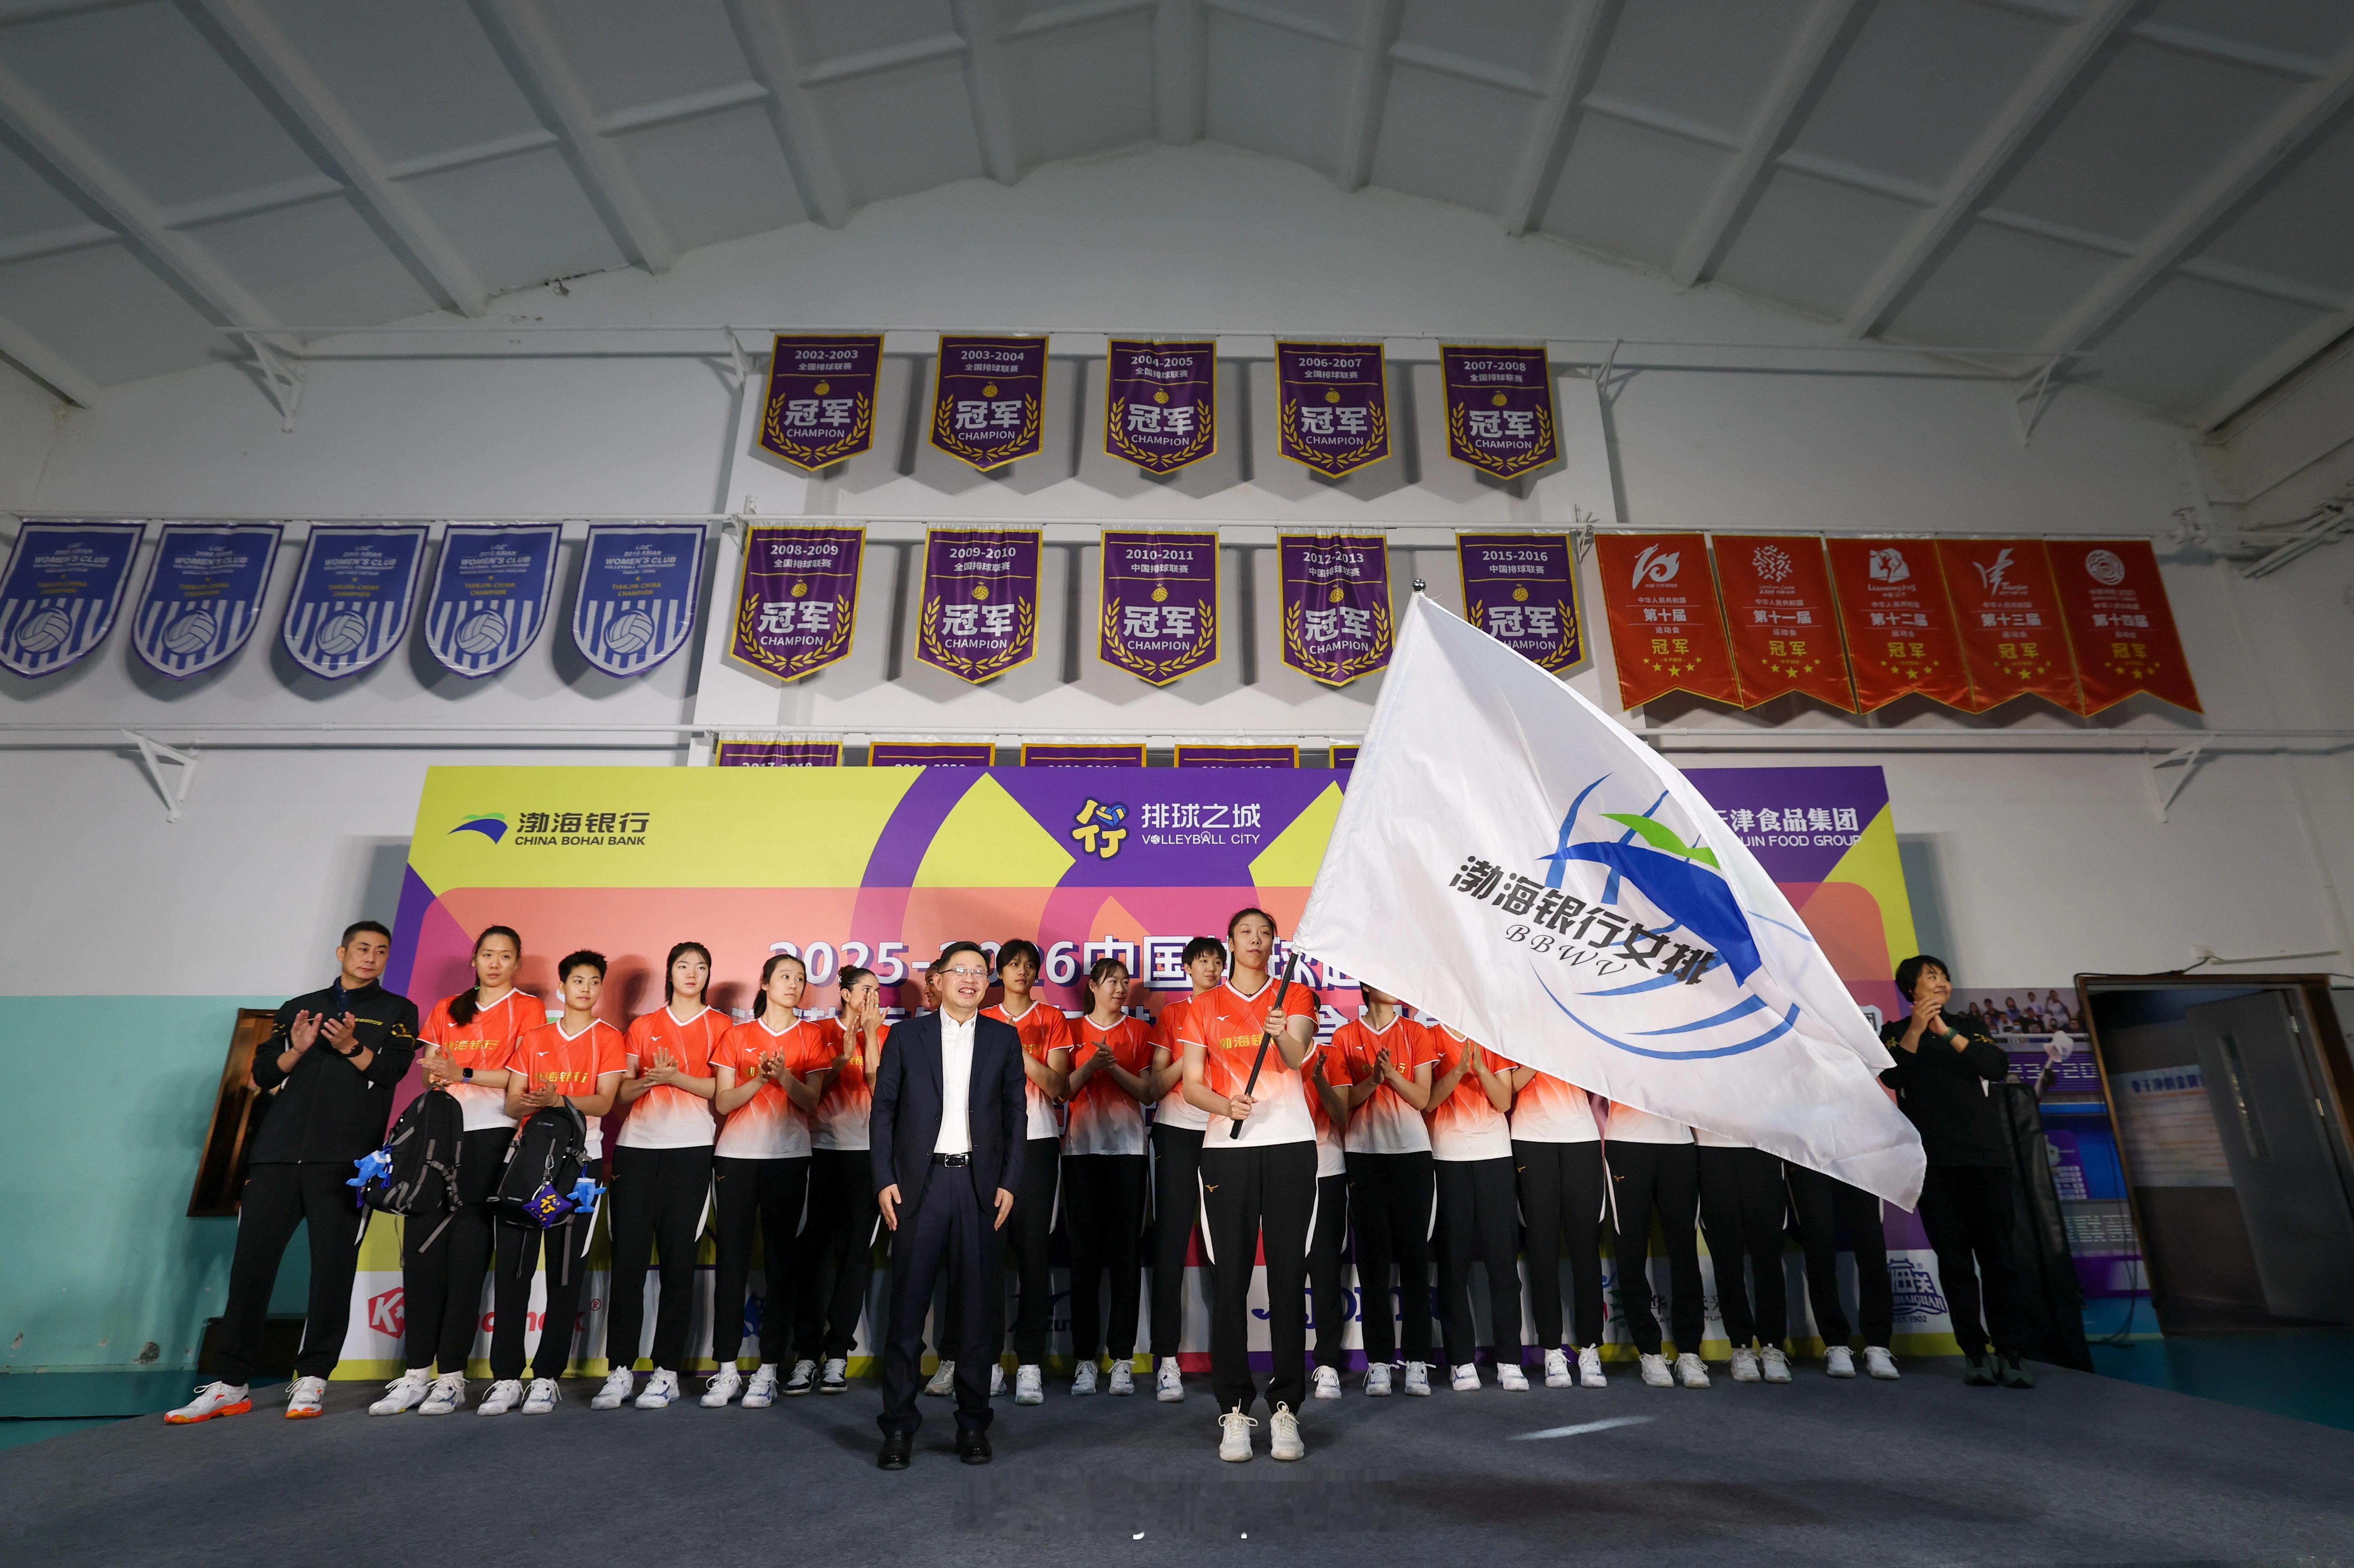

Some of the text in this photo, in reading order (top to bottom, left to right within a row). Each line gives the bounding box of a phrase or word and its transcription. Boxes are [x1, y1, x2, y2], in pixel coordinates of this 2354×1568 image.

[795, 350, 858, 360] 2002-2003
[961, 350, 1024, 361] 2003-2004
[798, 362, 852, 371] 全国排球联赛
[965, 363, 1019, 372] 全国排球联赛
[1131, 356, 1193, 367] 2004-2005
[1299, 357, 1361, 368] 2006-2007
[1464, 361, 1527, 372] 2007-2008
[1135, 367, 1188, 379] 全国排球联赛
[1304, 370, 1358, 379] 全国排球联赛
[1470, 373, 1523, 383] 全国排球联赛
[784, 398, 853, 426] 冠军
[955, 400, 1022, 429] 冠军
[1127, 403, 1194, 436] 冠军
[1301, 406, 1367, 435] 冠军
[1469, 410, 1535, 439] 冠军
[786, 429, 844, 438] CHAMPION
[958, 430, 1015, 441] CHAMPION
[1132, 434, 1190, 446] CHAMPION
[1306, 436, 1364, 445] CHAMPION
[1475, 439, 1532, 449] CHAMPION
[771, 544, 839, 556] 2008-2009
[949, 547, 1016, 559] 2009-2010
[1126, 549, 1193, 561] 2010-2011
[1303, 551, 1364, 564] 2012-2013
[1482, 551, 1548, 562] 2015-2016
[774, 558, 832, 569] 全国排球联赛
[953, 561, 1011, 572] 全国排球联赛
[1131, 564, 1189, 574] 中国排球联赛
[1489, 564, 1545, 574] 中国排球联赛
[1309, 566, 1360, 578] 中国排球联赛
[758, 601, 834, 634] 冠军
[941, 604, 1015, 637] 冠军
[1643, 608, 1687, 622] 第十届
[1753, 609, 1812, 624] 第十一届
[1870, 612, 1928, 627] 第十二届
[1981, 613, 2042, 627] 第十三届
[1123, 606, 1196, 638] 冠军
[1305, 607, 1371, 642] 冠军
[1488, 606, 1558, 638] 冠军
[760, 635, 824, 645] CHAMPION
[945, 639, 1007, 649] CHAMPION
[1127, 640, 1190, 650] CHAMPION
[1503, 640, 1556, 649] HAMPION
[1309, 640, 1369, 655] CHAMPION
[1651, 639, 1689, 654] 冠军
[1769, 640, 1807, 657] 冠军
[1887, 642, 1926, 658] 冠军
[1998, 643, 2039, 659] 冠军
[1141, 803, 1261, 828] 排球之城
[517, 812, 650, 833] 渤海银行
[515, 836, 645, 845] CHINA BOHAI BANK
[1142, 833, 1260, 845] VOLLEYBALL CITY
[1769, 836, 1810, 846] FOOD
[1813, 835, 1862, 846] GROUP
[1449, 856, 1717, 985] 渤海银行女排
